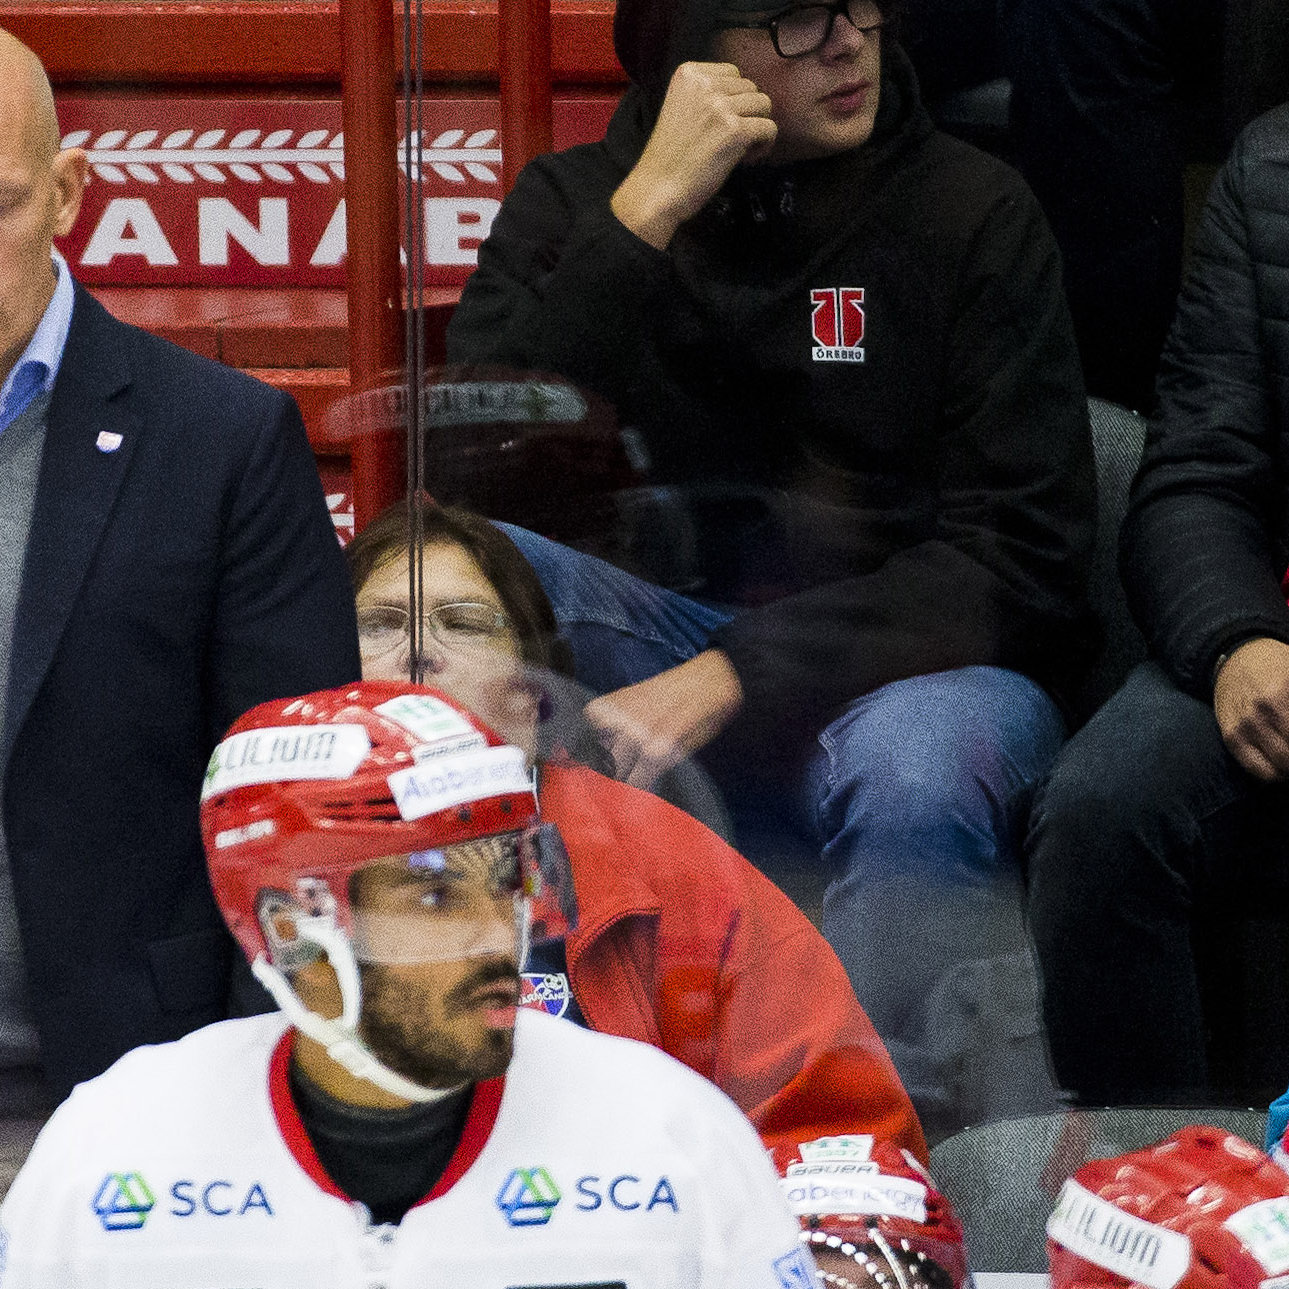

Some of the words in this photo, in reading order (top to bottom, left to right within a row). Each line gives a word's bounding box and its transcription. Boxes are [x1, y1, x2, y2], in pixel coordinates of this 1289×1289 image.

[815, 348, 862, 360] ÖREBRO
[170, 1179, 274, 1217] SCA
[575, 1175, 679, 1214] SCA
